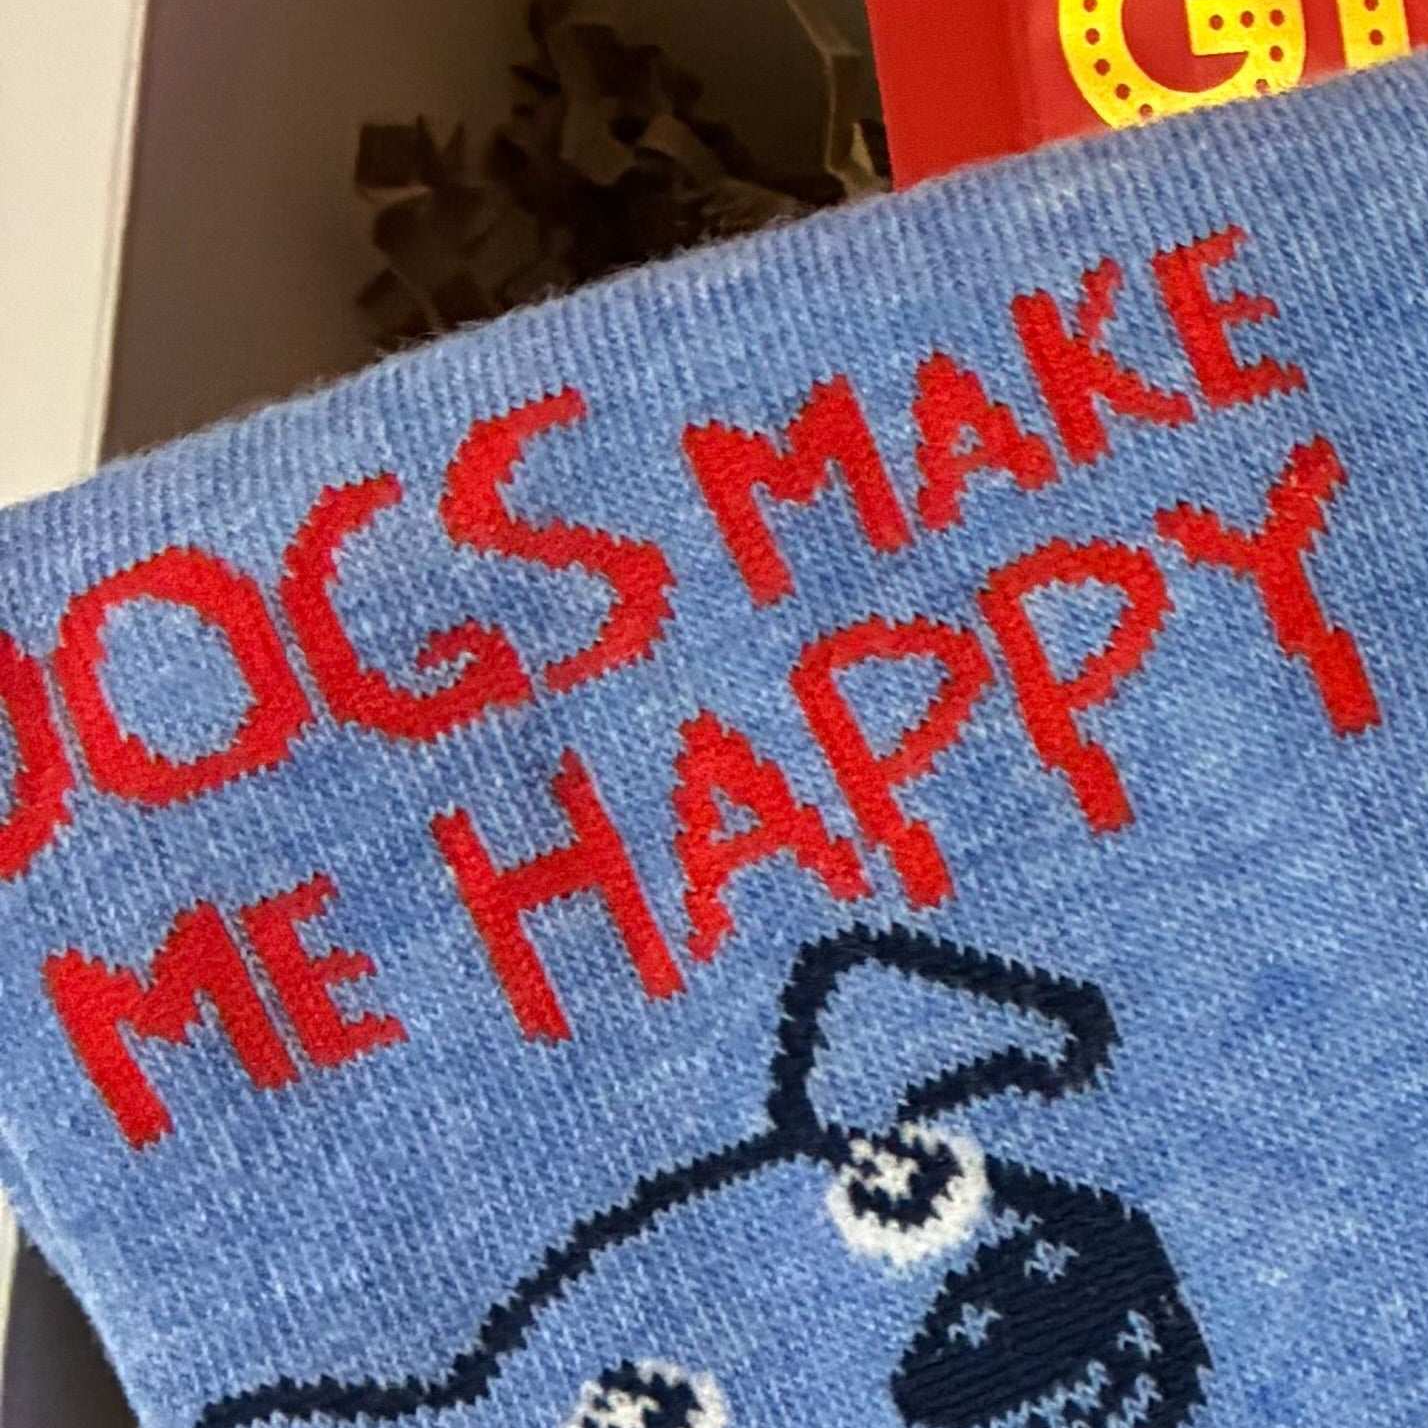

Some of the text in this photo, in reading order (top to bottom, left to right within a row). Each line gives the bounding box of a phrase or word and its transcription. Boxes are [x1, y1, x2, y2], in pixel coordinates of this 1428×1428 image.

[681, 225, 1306, 607] MAKE
[42, 873, 407, 1149] ME
[431, 435, 1382, 1043] HAPPY
